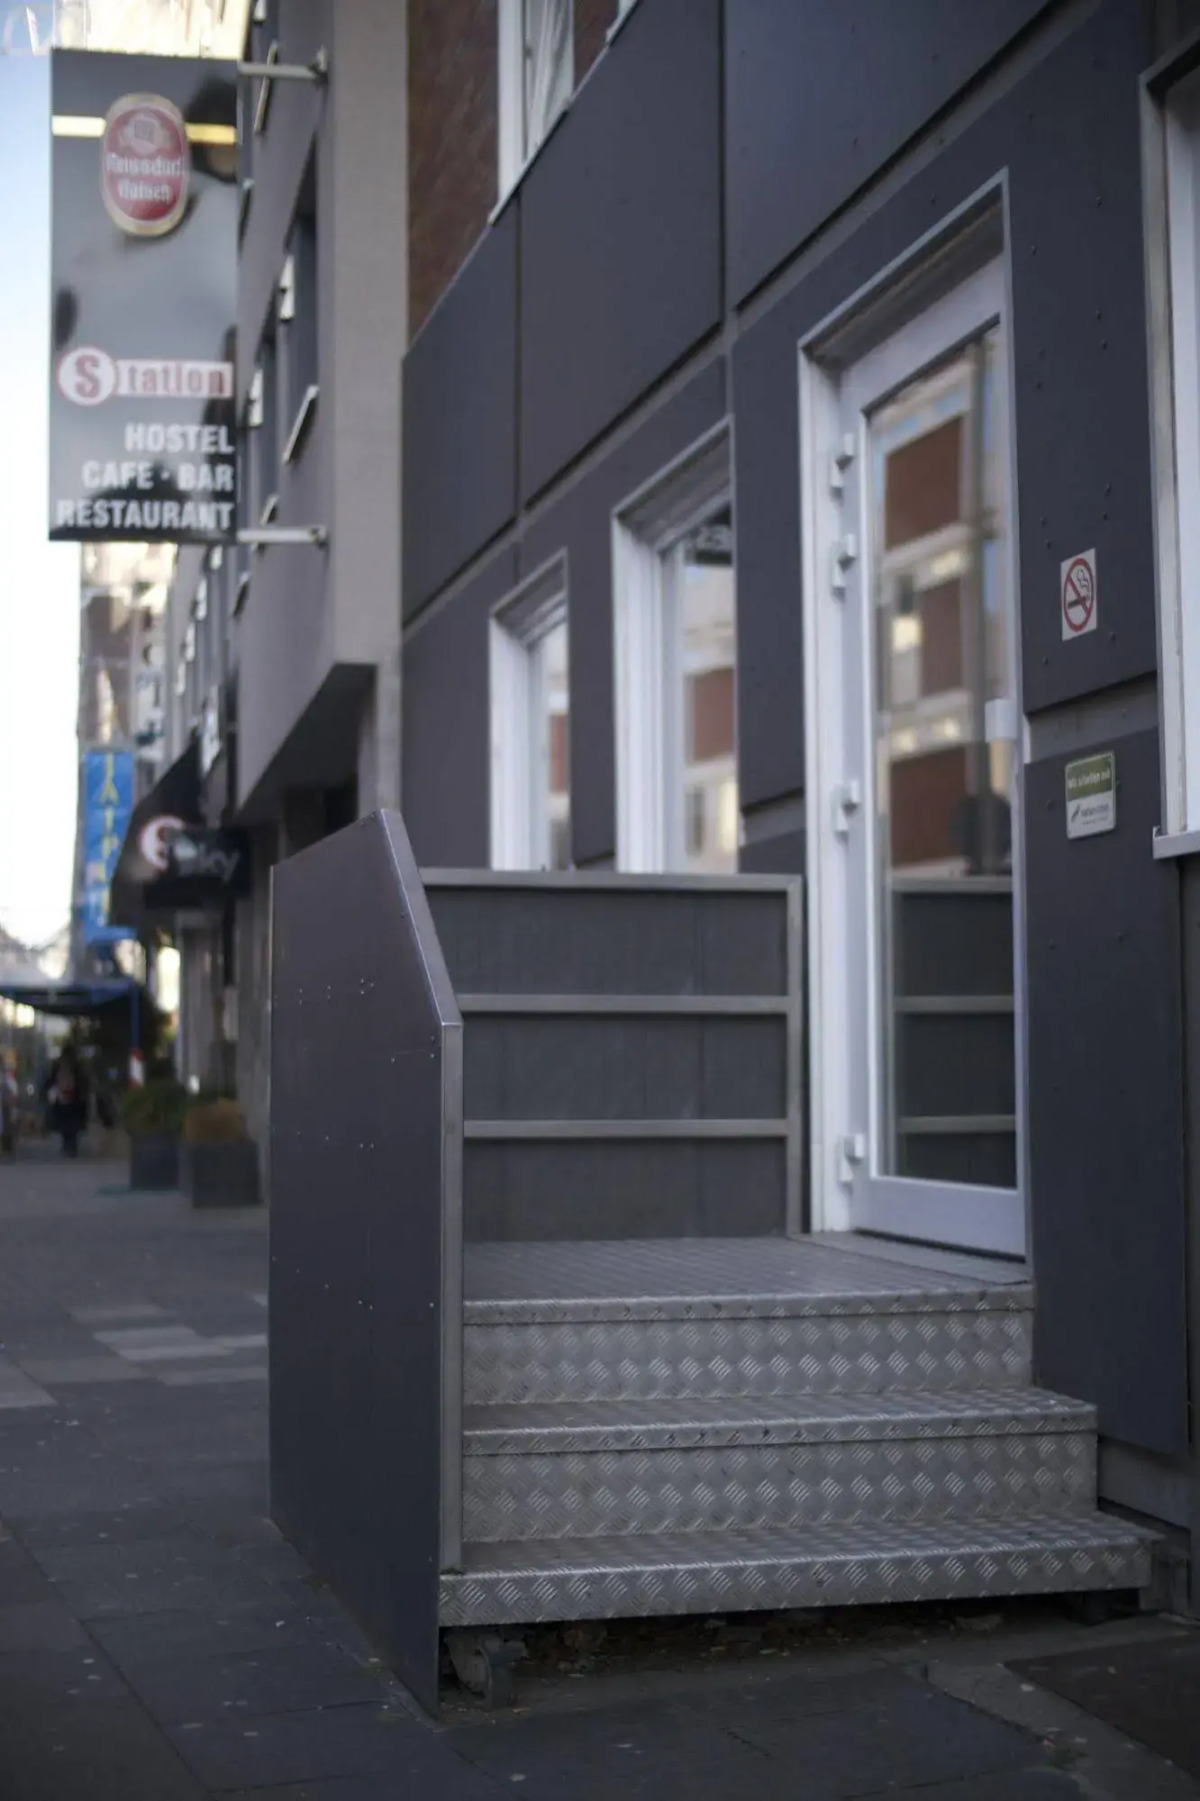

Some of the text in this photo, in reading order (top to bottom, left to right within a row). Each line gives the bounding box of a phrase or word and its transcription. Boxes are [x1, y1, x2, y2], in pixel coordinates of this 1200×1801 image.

[74, 354, 225, 398] Station
[124, 423, 235, 454] HOSTEL
[81, 460, 234, 492] CAFE BAR
[55, 499, 235, 530] RESTAURANT
